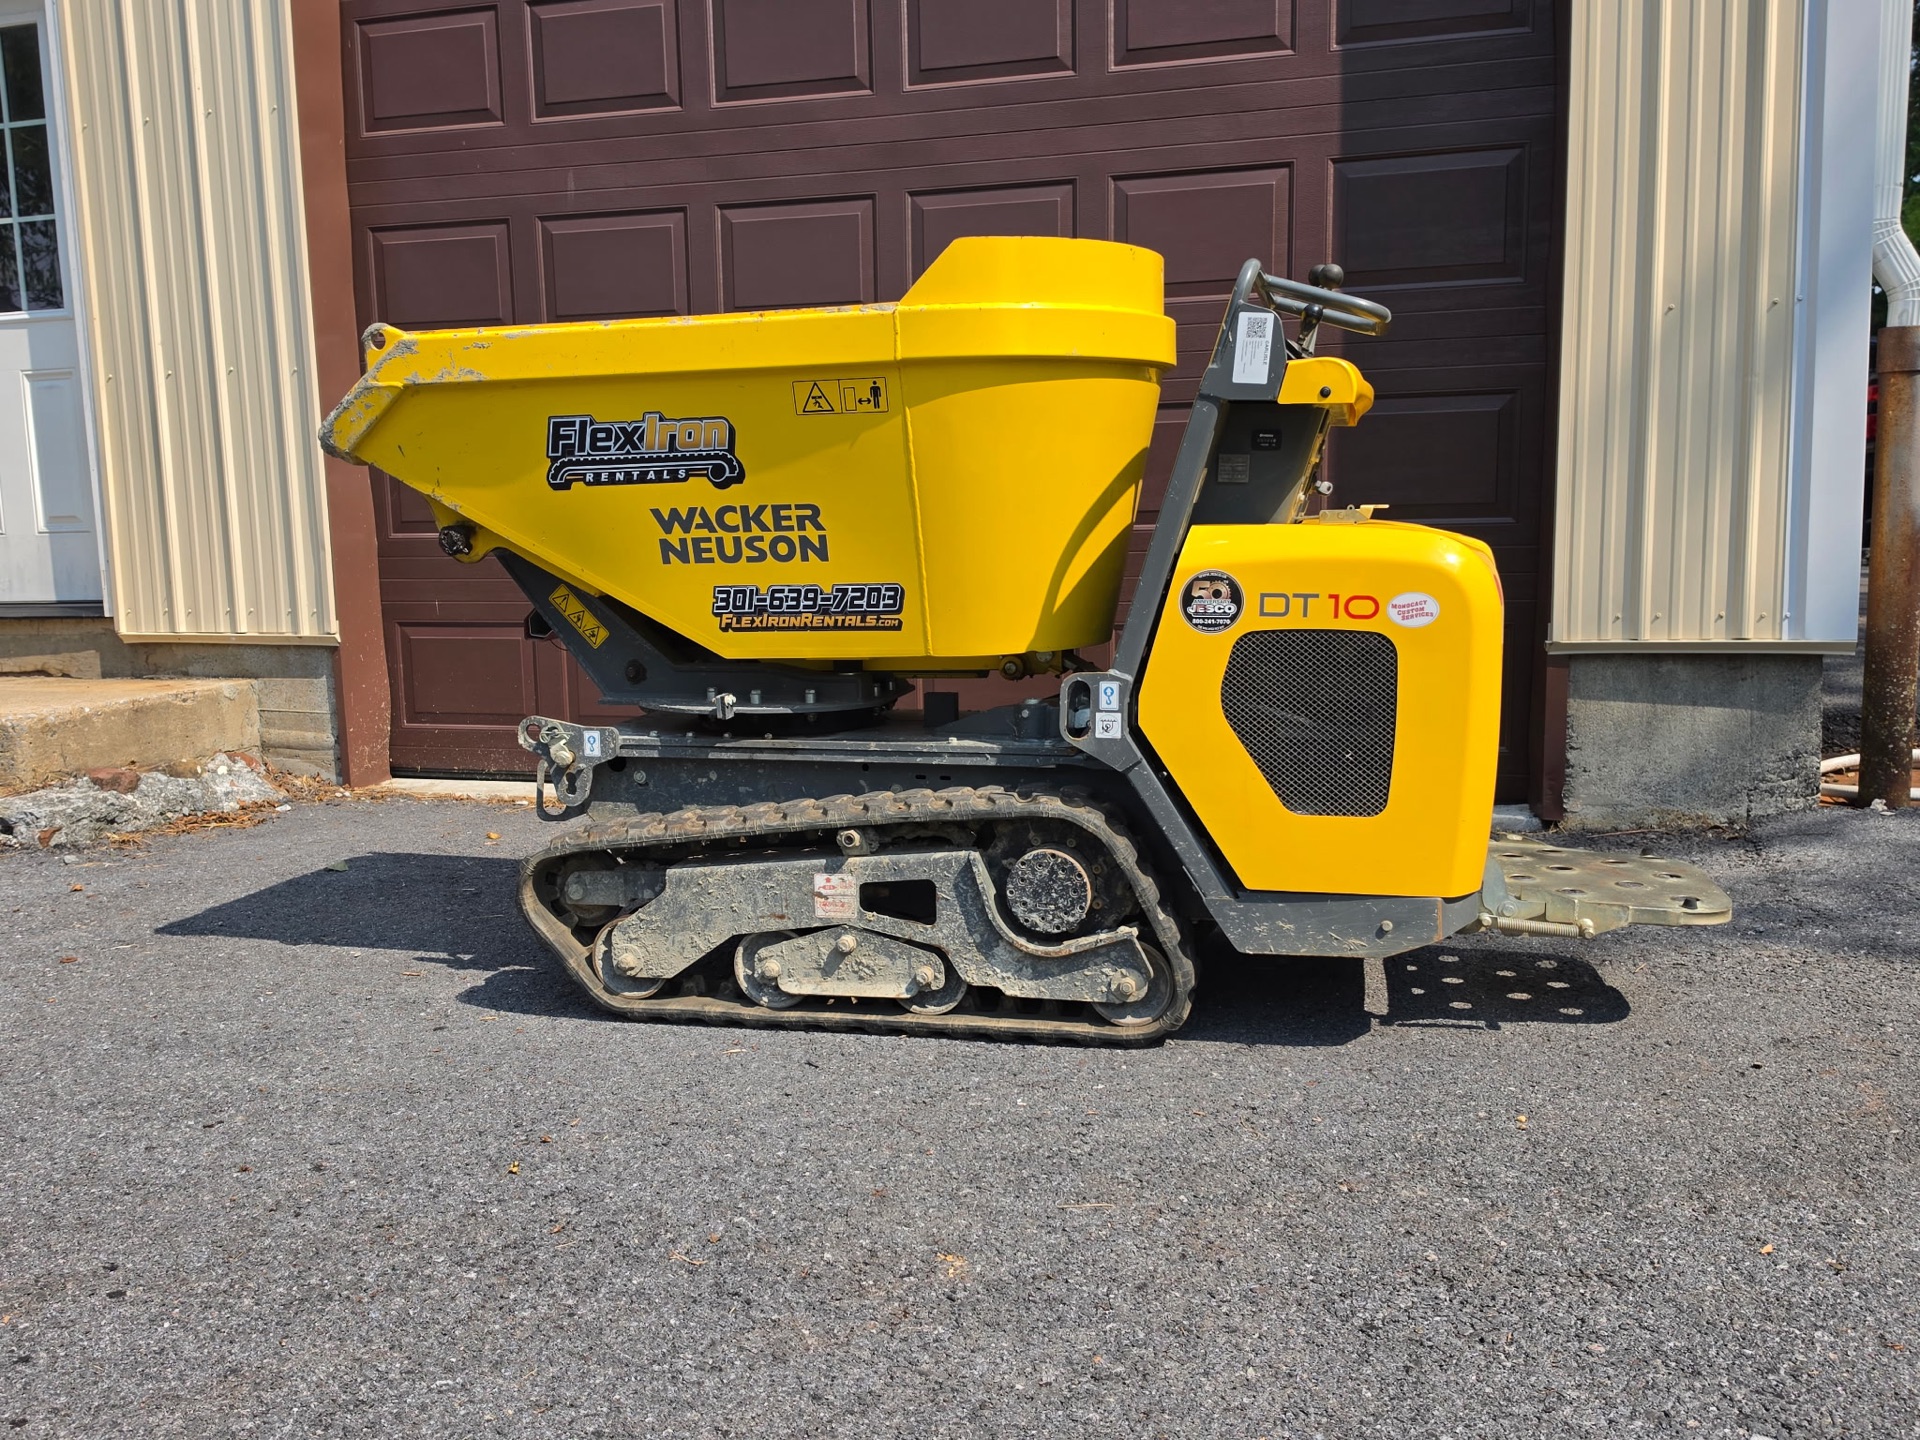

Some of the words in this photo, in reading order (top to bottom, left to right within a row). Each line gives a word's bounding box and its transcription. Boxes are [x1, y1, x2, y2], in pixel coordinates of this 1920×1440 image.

[550, 414, 729, 456] FlexIron
[586, 469, 686, 482] RENTALS
[649, 503, 826, 534] WACKER
[659, 535, 829, 564] NEUSON
[713, 585, 900, 612] 301-639-7203
[1191, 580, 1231, 599] 50
[1189, 604, 1235, 613] JESCO
[1259, 593, 1320, 618] DT
[1328, 594, 1380, 619] 10
[1397, 607, 1425, 615] CUSTOM
[1401, 612, 1434, 620] SERVICES
